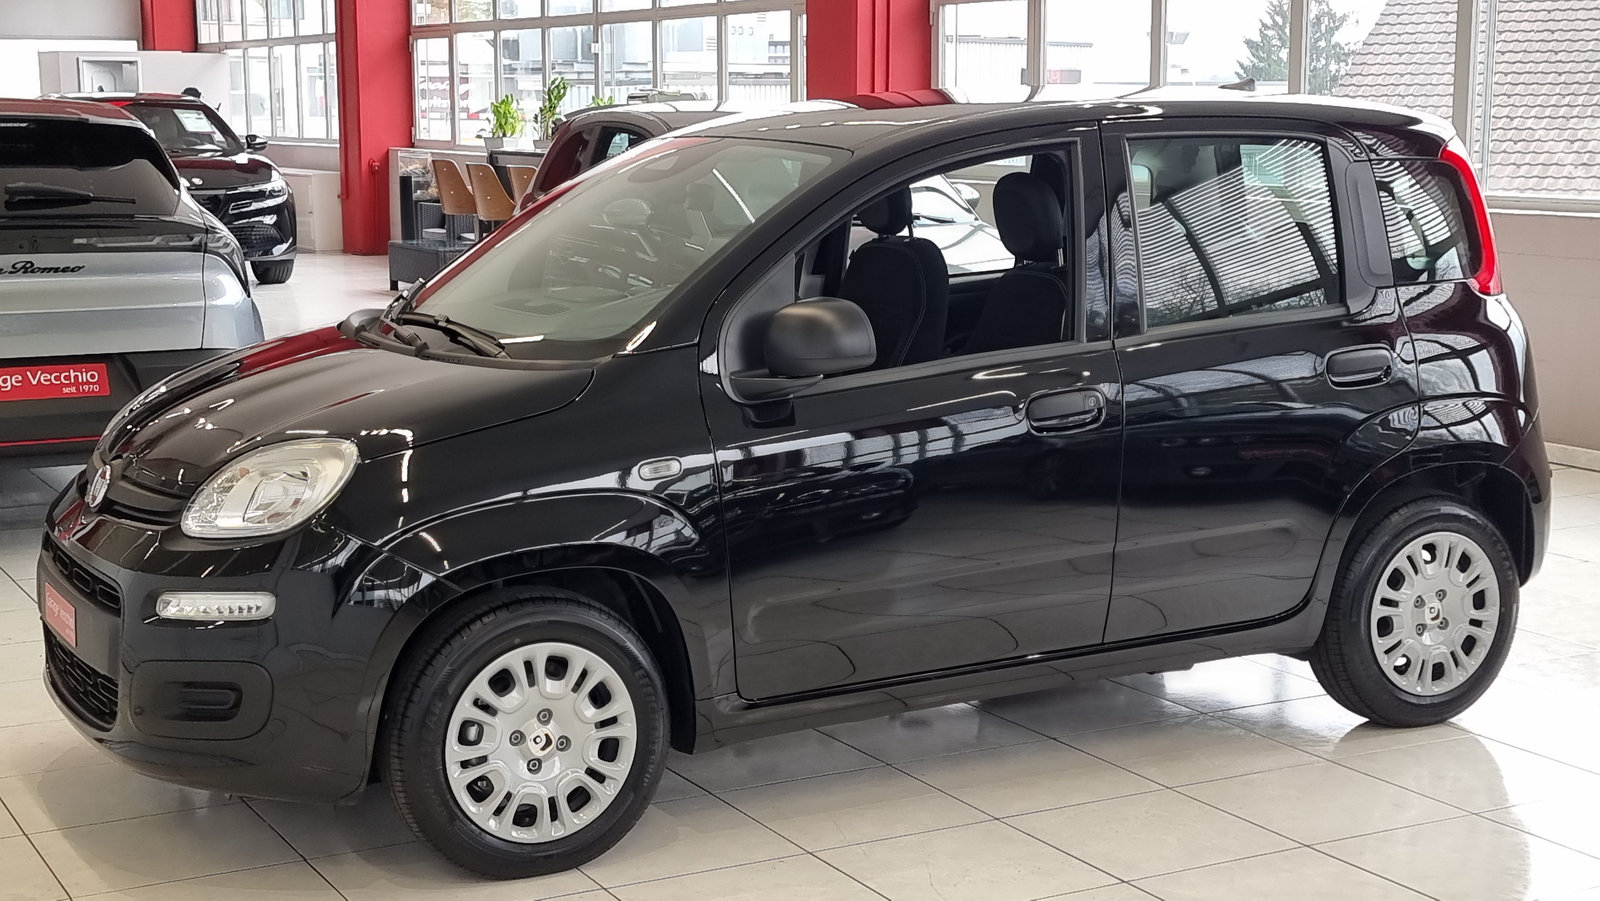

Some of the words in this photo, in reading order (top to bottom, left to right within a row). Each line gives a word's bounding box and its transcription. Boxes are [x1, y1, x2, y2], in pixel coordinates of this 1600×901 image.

[9, 261, 85, 274] Romeo
[26, 368, 98, 384] Vecchio
[62, 385, 76, 394] seit
[79, 384, 99, 392] 1970
